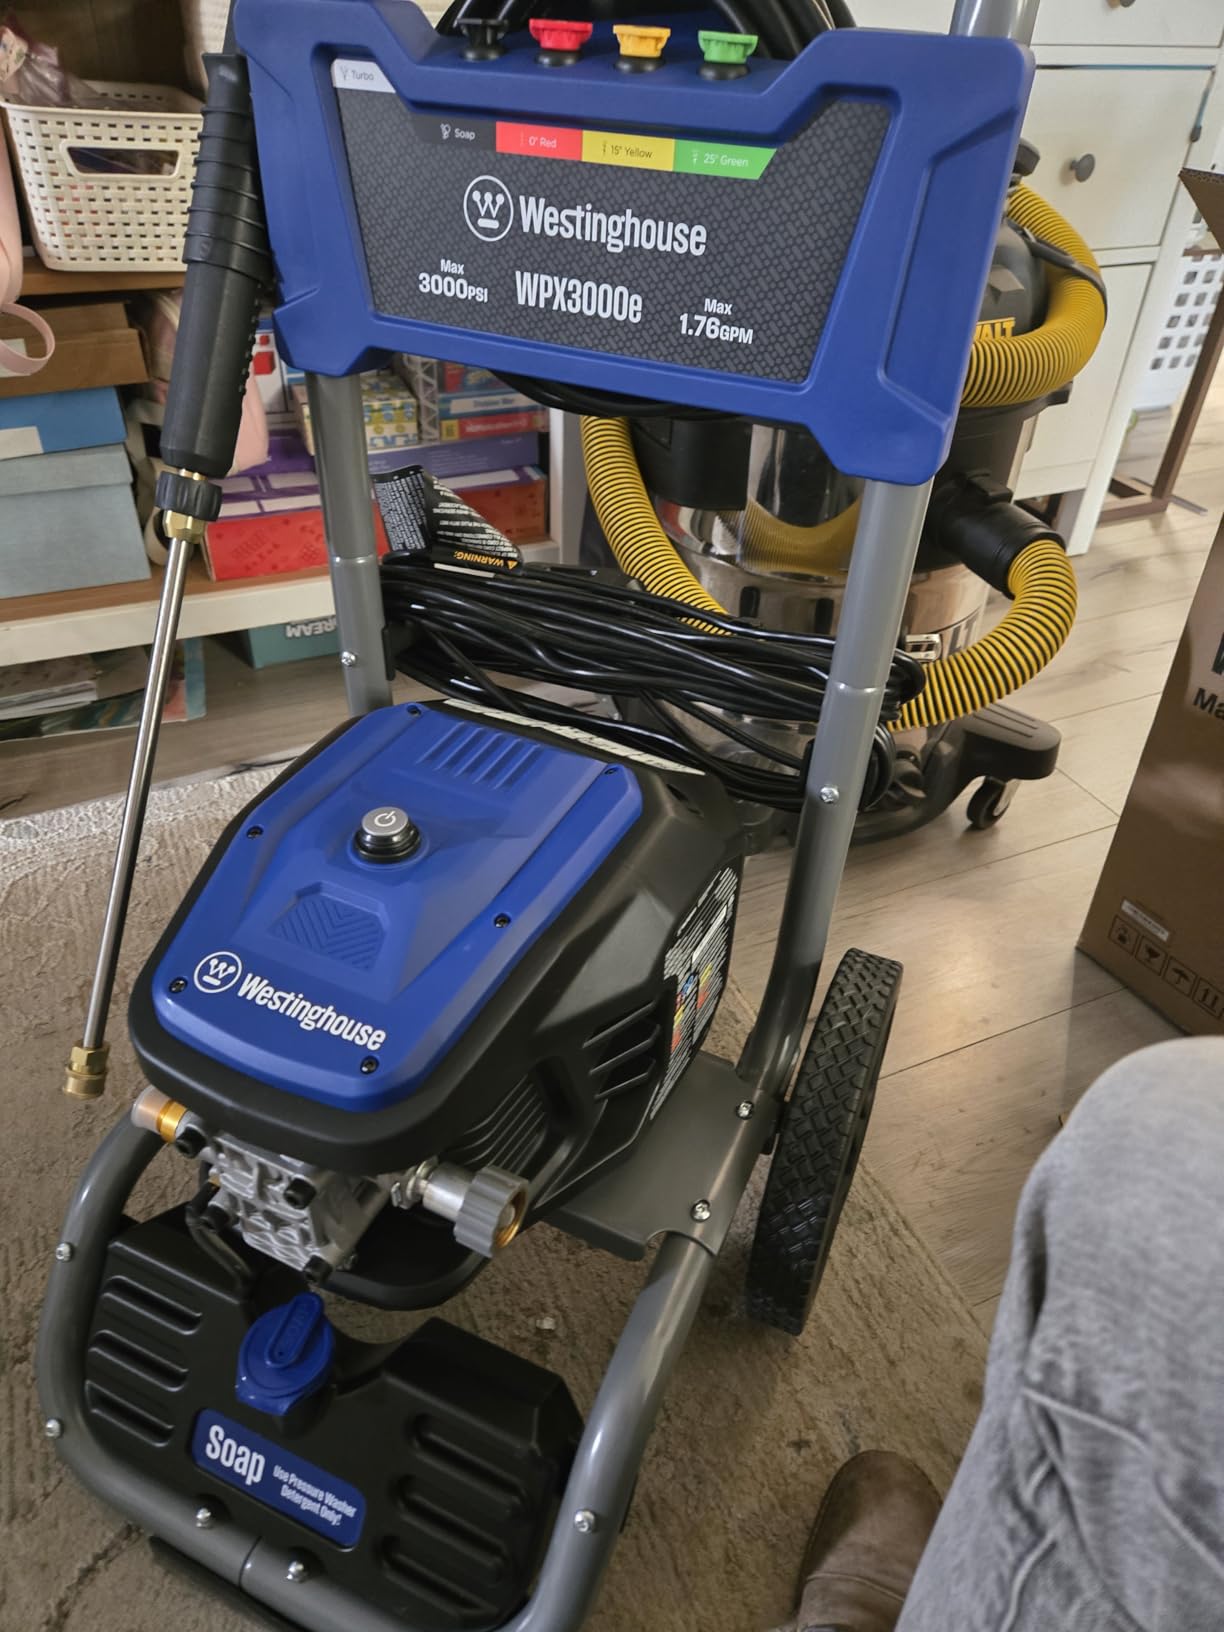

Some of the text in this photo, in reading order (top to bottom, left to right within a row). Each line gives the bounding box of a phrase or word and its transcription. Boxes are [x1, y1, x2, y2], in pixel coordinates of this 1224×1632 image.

[351, 70, 375, 81] Turbo
[454, 128, 476, 142] Soap
[539, 137, 557, 149] Red
[624, 146, 653, 160] Yellow
[719, 155, 749, 168] Green
[519, 195, 707, 256] Westinghouse
[440, 259, 464, 275] Max
[515, 270, 643, 324] WPX3000e
[704, 298, 732, 315] Max
[453, 551, 504, 567] WARNING:
[238, 972, 387, 1051] Westinghouse
[205, 1424, 266, 1486] Soap
[273, 1464, 358, 1518] Use Pressure Washer
[280, 1484, 343, 1526] Detergent Only!
